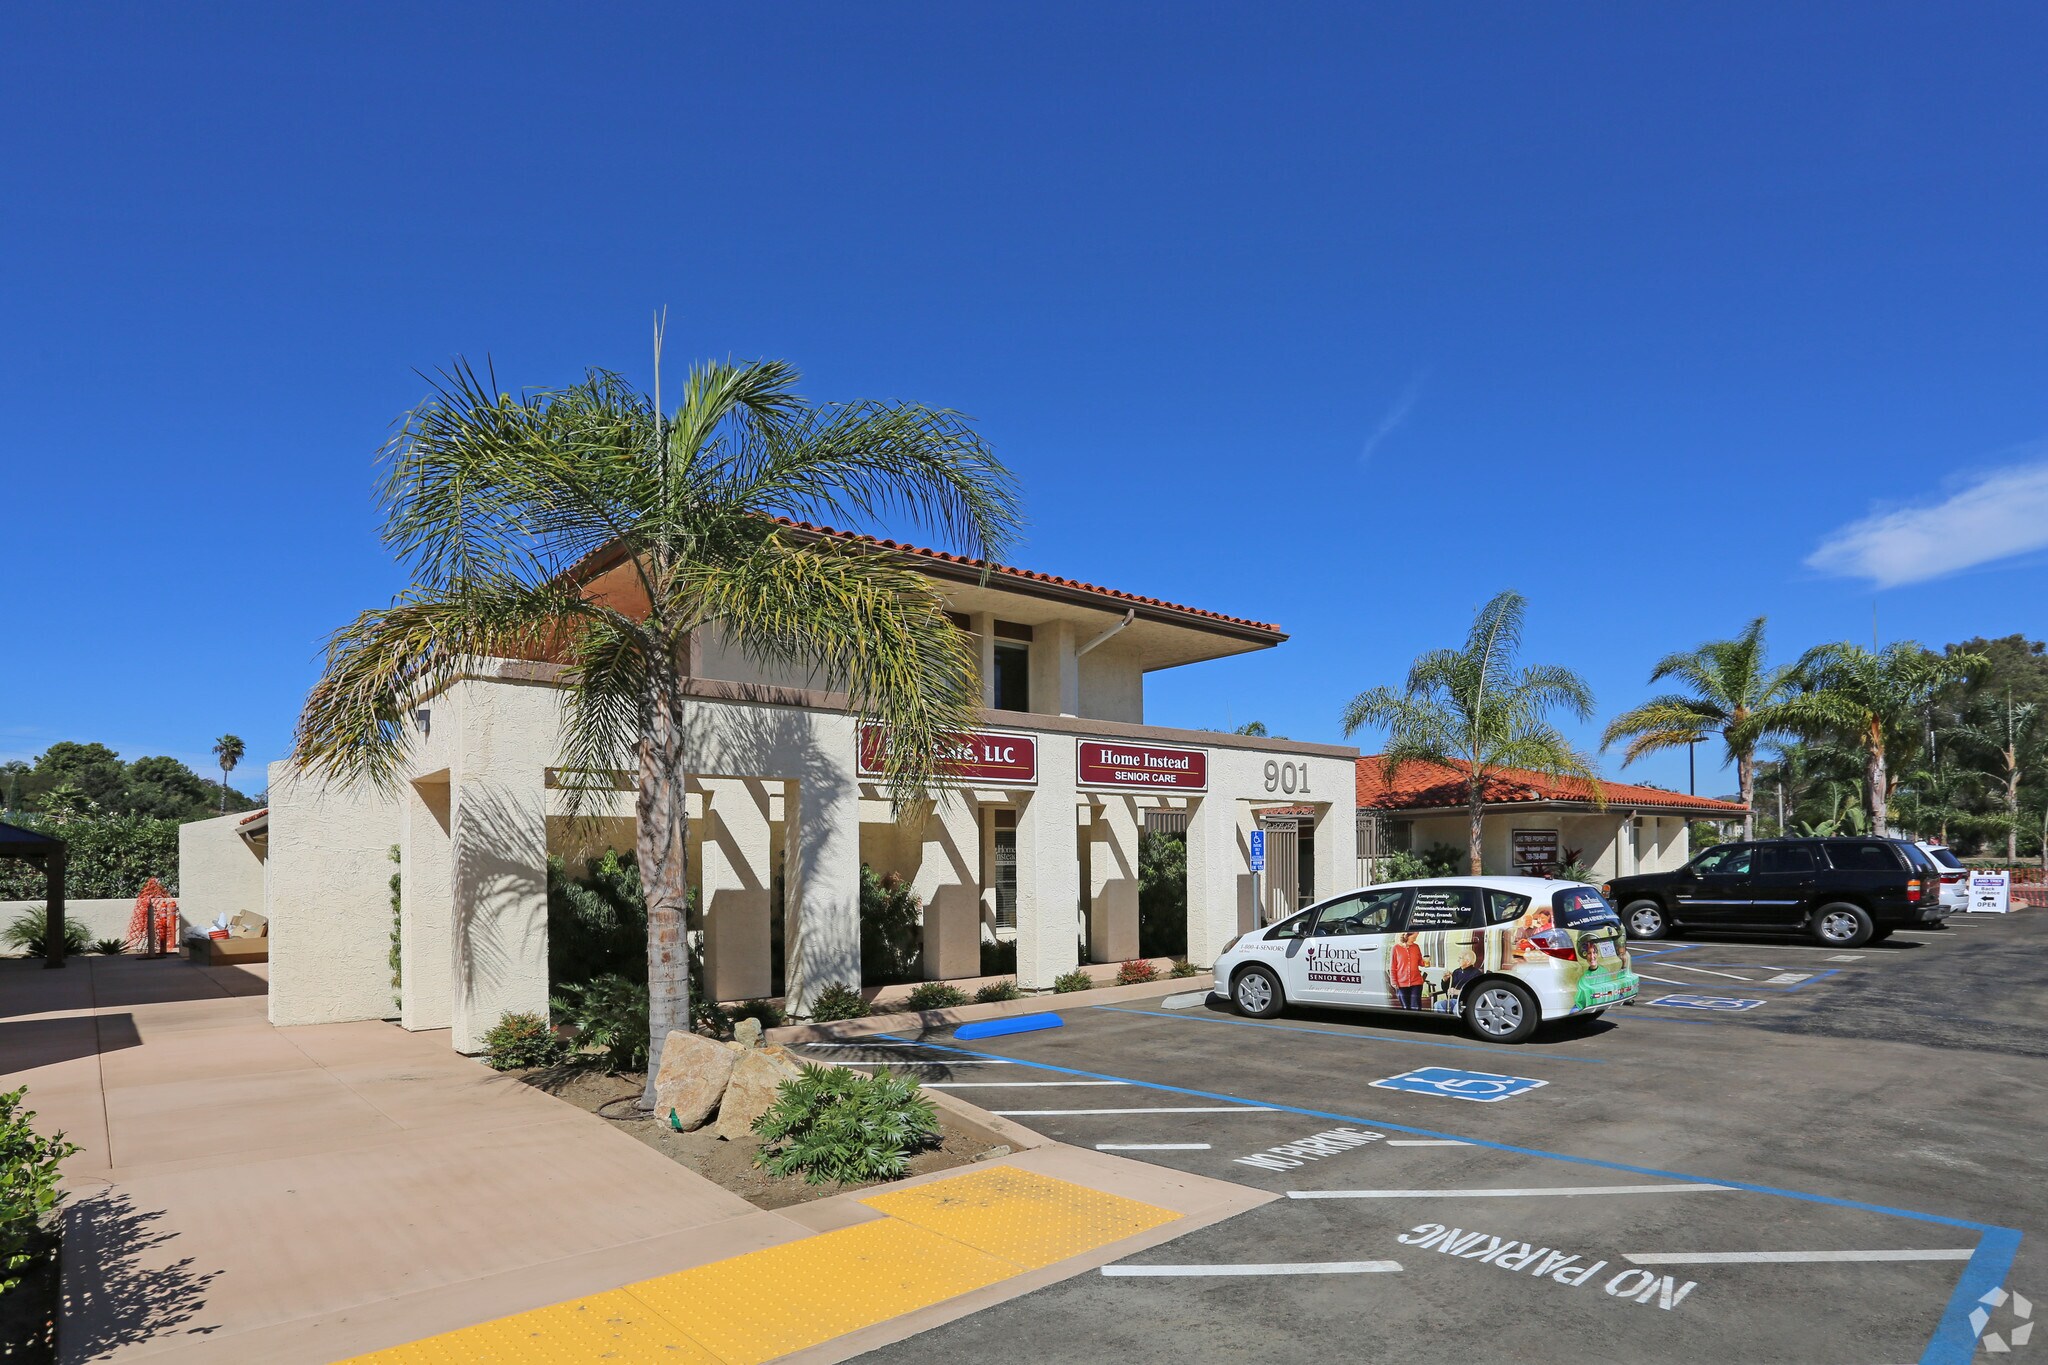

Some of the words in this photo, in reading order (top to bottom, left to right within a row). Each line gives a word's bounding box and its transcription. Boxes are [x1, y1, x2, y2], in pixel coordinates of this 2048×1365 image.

[984, 745, 1016, 764] LLC
[1100, 749, 1140, 766] Home
[1143, 752, 1189, 770] Instead
[1114, 771, 1150, 782] SENIOR
[1152, 773, 1177, 783] CARE
[1263, 759, 1311, 795] 901
[1317, 943, 1357, 960] Home
[1308, 955, 1360, 974] Instead
[1340, 975, 1360, 983] CARE
[1266, 1127, 1386, 1161] PARKING
[1232, 1153, 1305, 1172] NO
[1397, 1223, 1608, 1287] PARKING
[1605, 1268, 1698, 1311] NO
